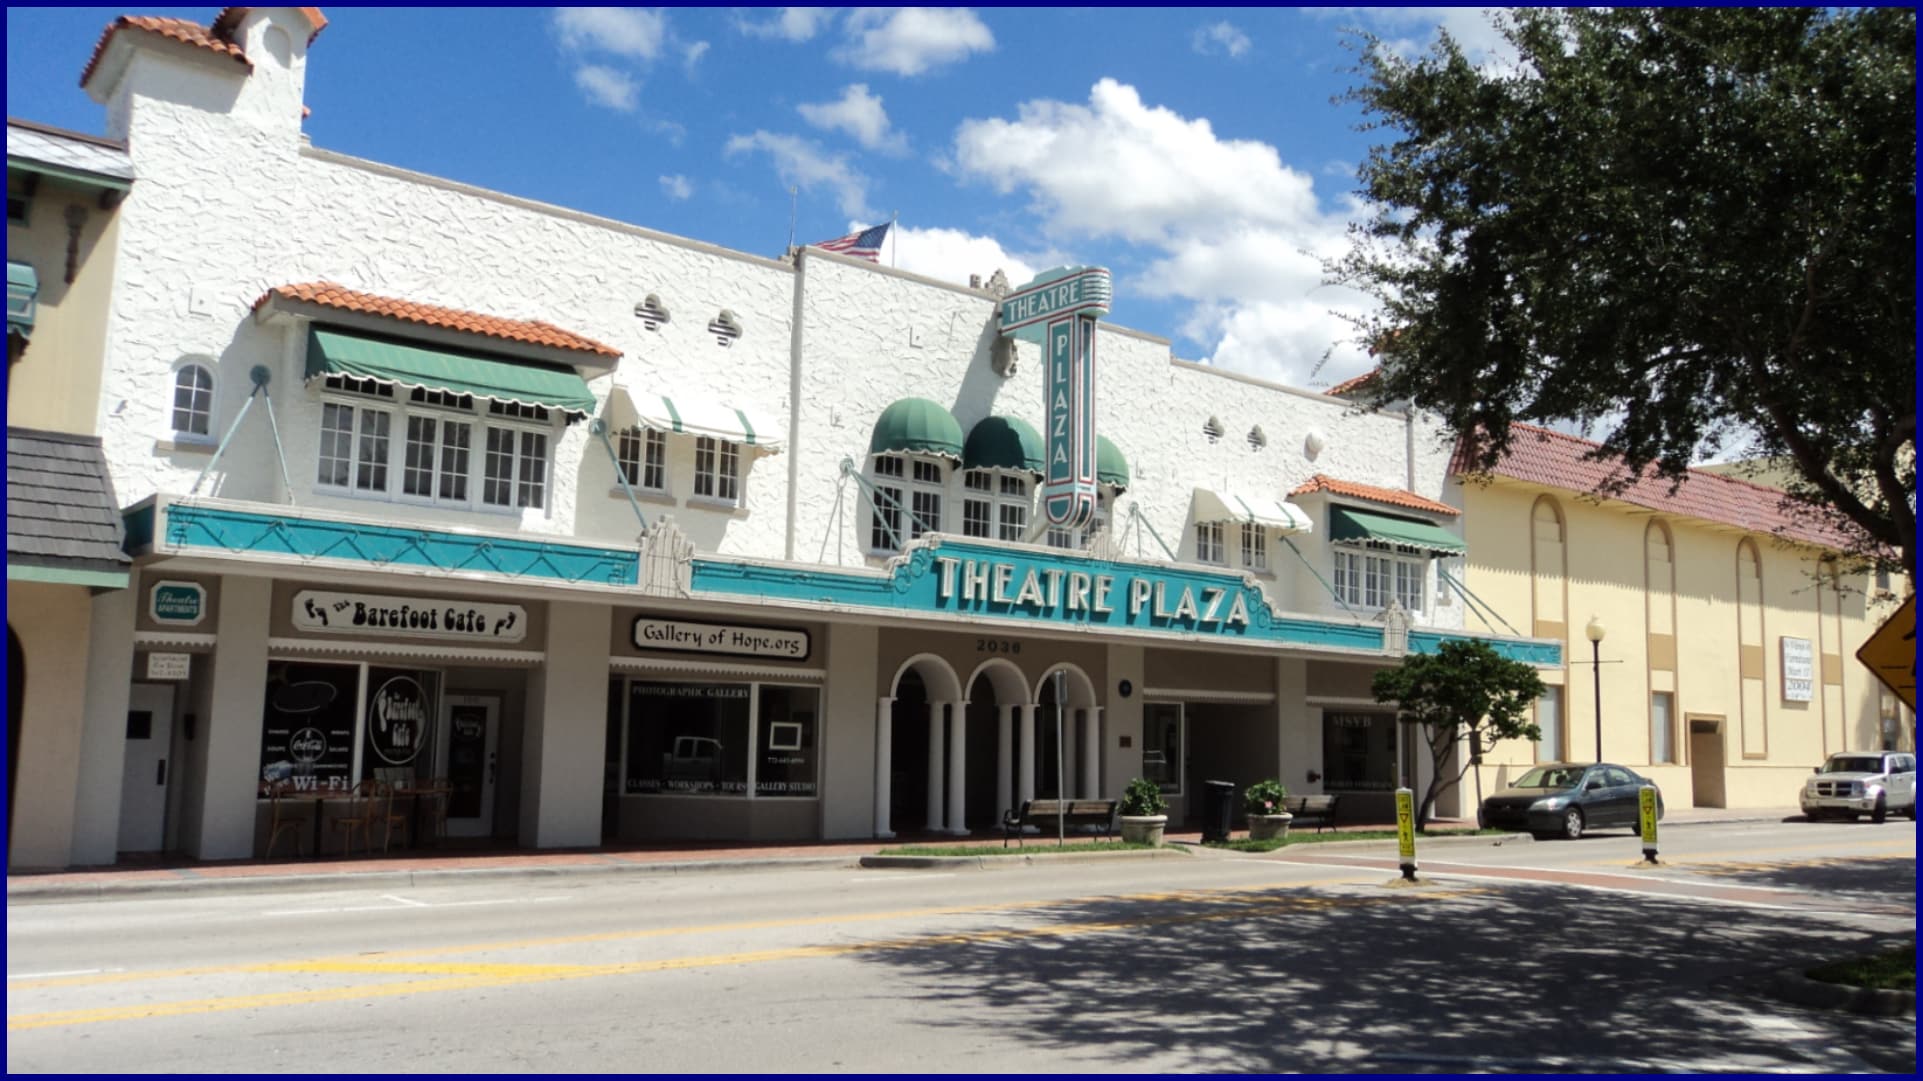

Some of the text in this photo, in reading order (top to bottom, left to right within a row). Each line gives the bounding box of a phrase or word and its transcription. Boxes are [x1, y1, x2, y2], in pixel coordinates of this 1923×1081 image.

[1007, 280, 1079, 322] THEATRE
[1053, 334, 1068, 465] PLAZA
[936, 556, 1250, 626] THEATRE PLAZA
[352, 602, 438, 630] Barefoot
[444, 608, 486, 633] Cafe
[643, 624, 801, 655] Gallery of Hope.org
[633, 686, 749, 699] PHOTOGRAPHIC GALLERY
[291, 775, 349, 791] Wi-Fi
[667, 780, 715, 791] WORKSHOPS
[755, 782, 817, 792] GALLERY STUDIO
